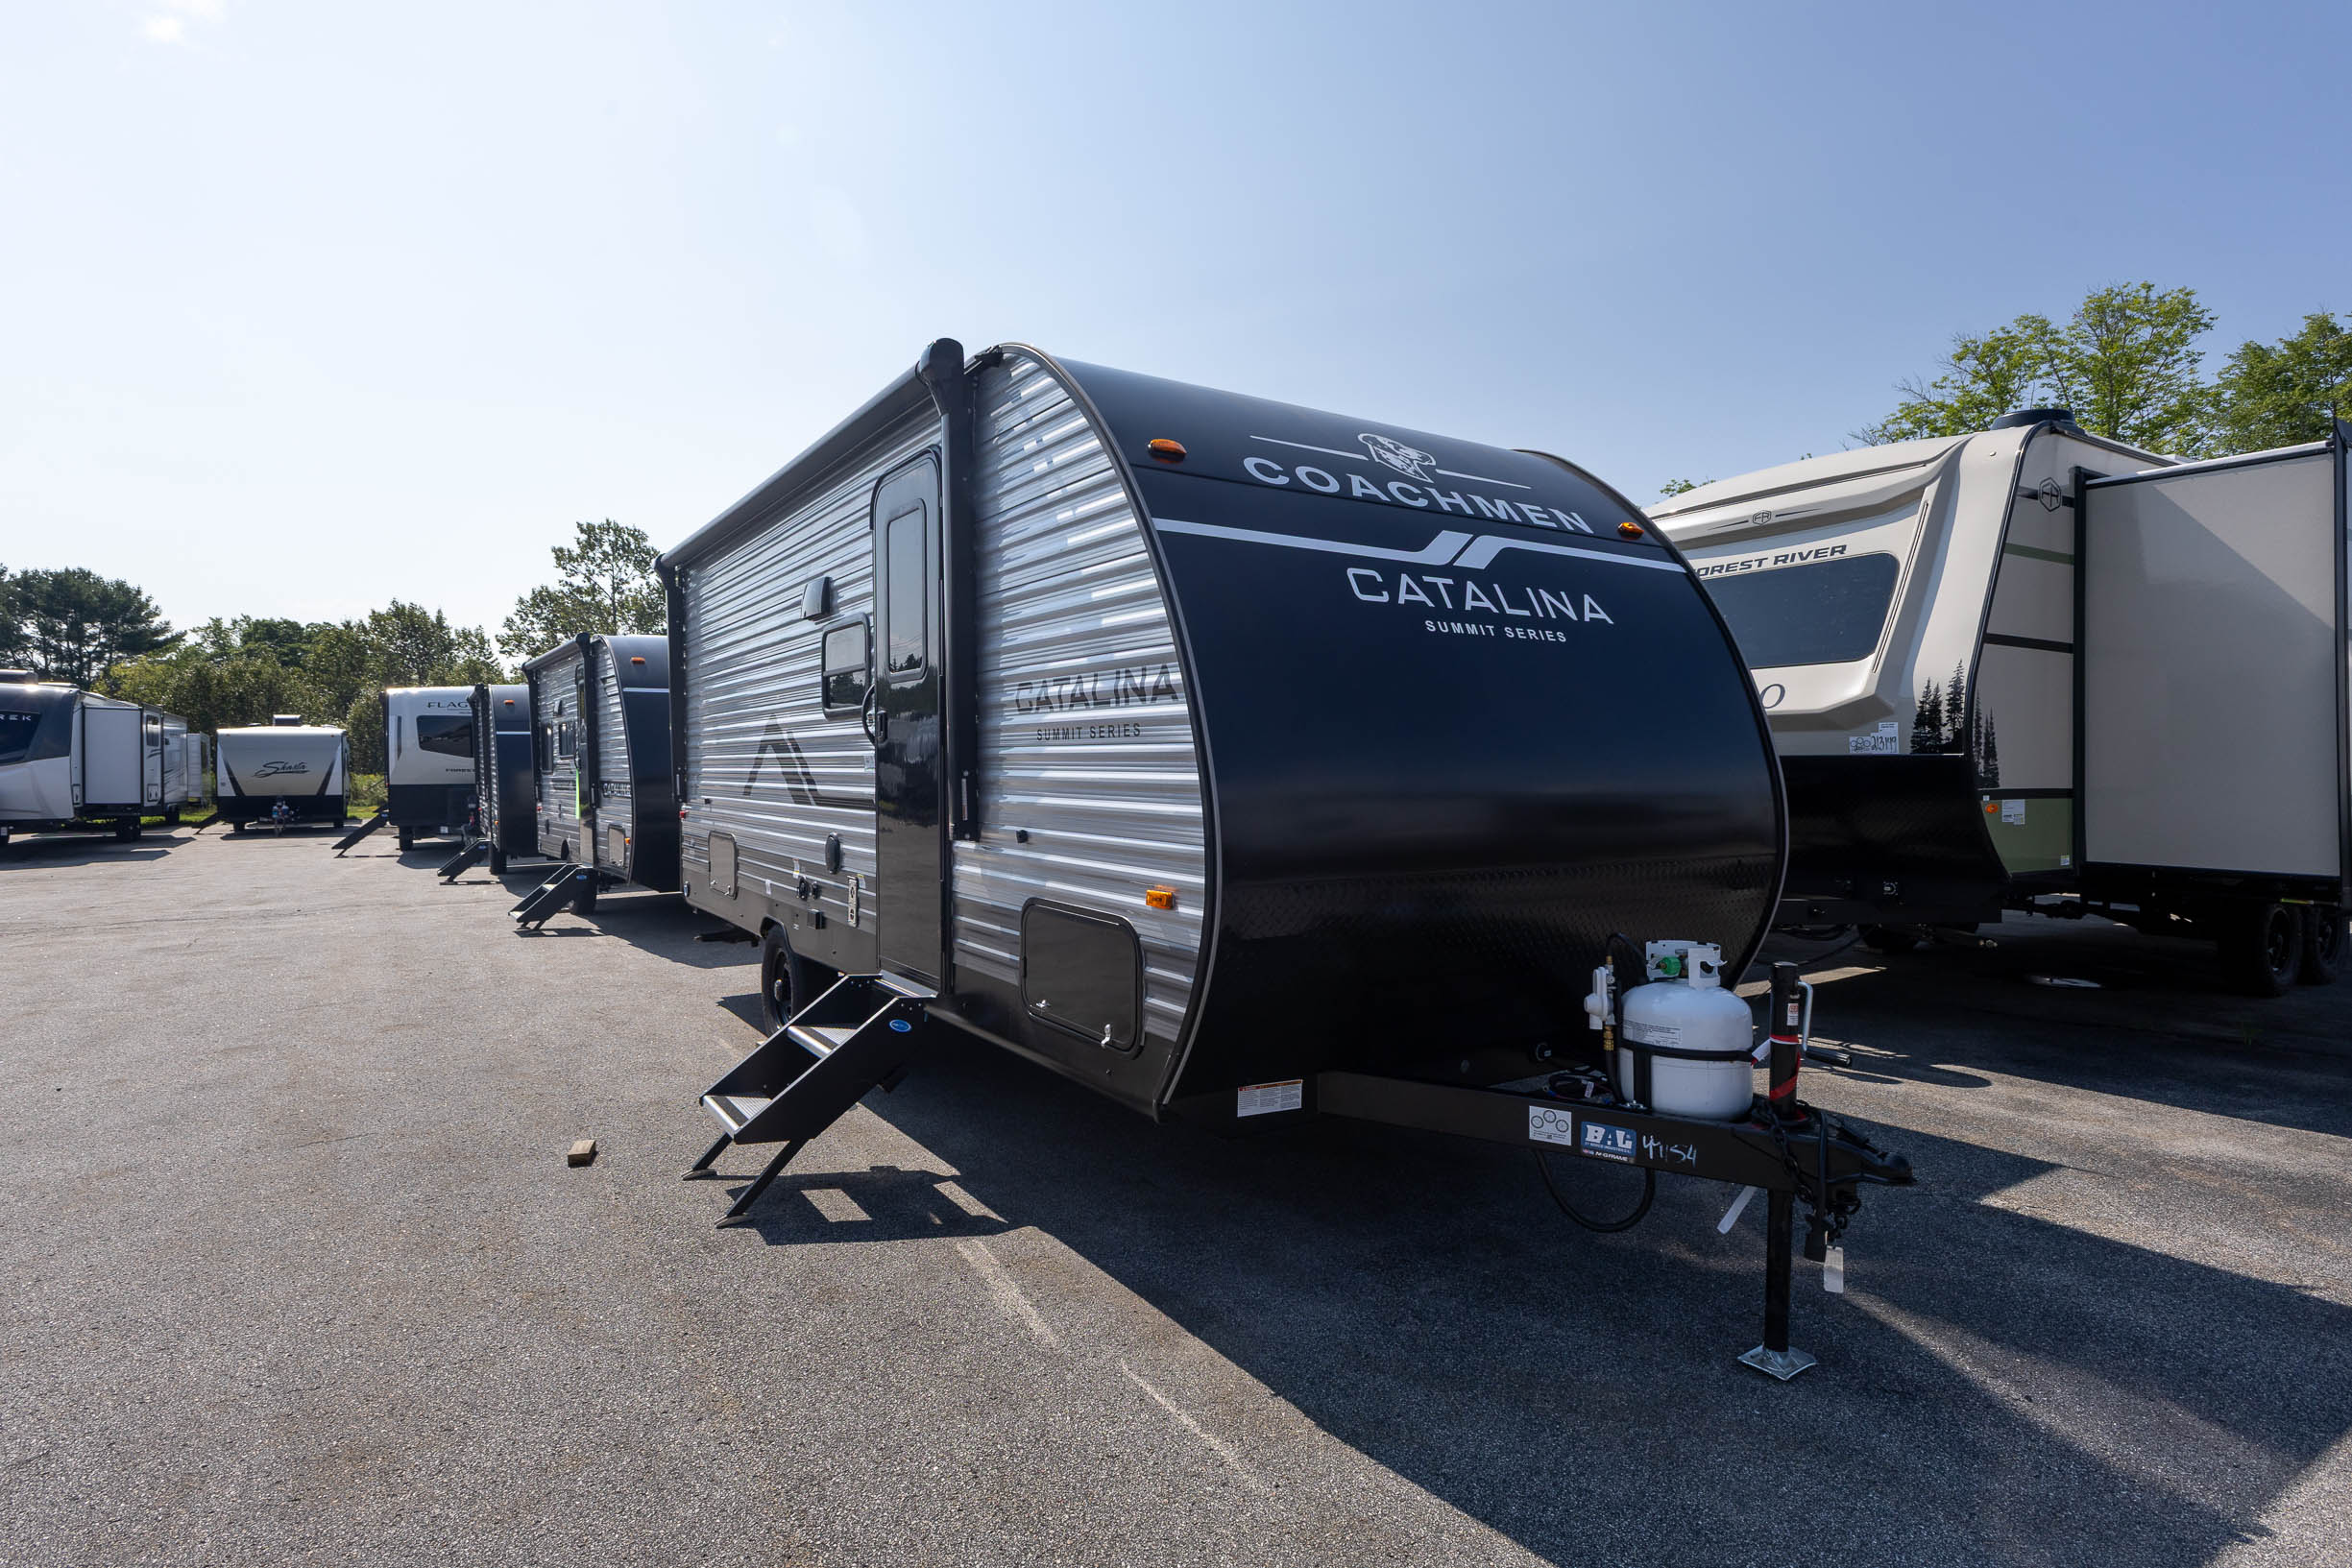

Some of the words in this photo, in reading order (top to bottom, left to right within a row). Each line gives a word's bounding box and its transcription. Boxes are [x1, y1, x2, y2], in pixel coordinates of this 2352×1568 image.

[1243, 456, 1594, 535] COACHMEN
[1694, 557, 1768, 577] OREST
[1773, 544, 1847, 566] RIVER
[1346, 567, 1614, 625] CATALINA
[1424, 619, 1496, 638] SUMMIT
[1504, 626, 1567, 642] SERIES
[1015, 663, 1179, 713] CATALINA
[1036, 726, 1082, 741] SUMMIT
[1089, 723, 1142, 738] SERIES
[1585, 1124, 1633, 1149] BAL
